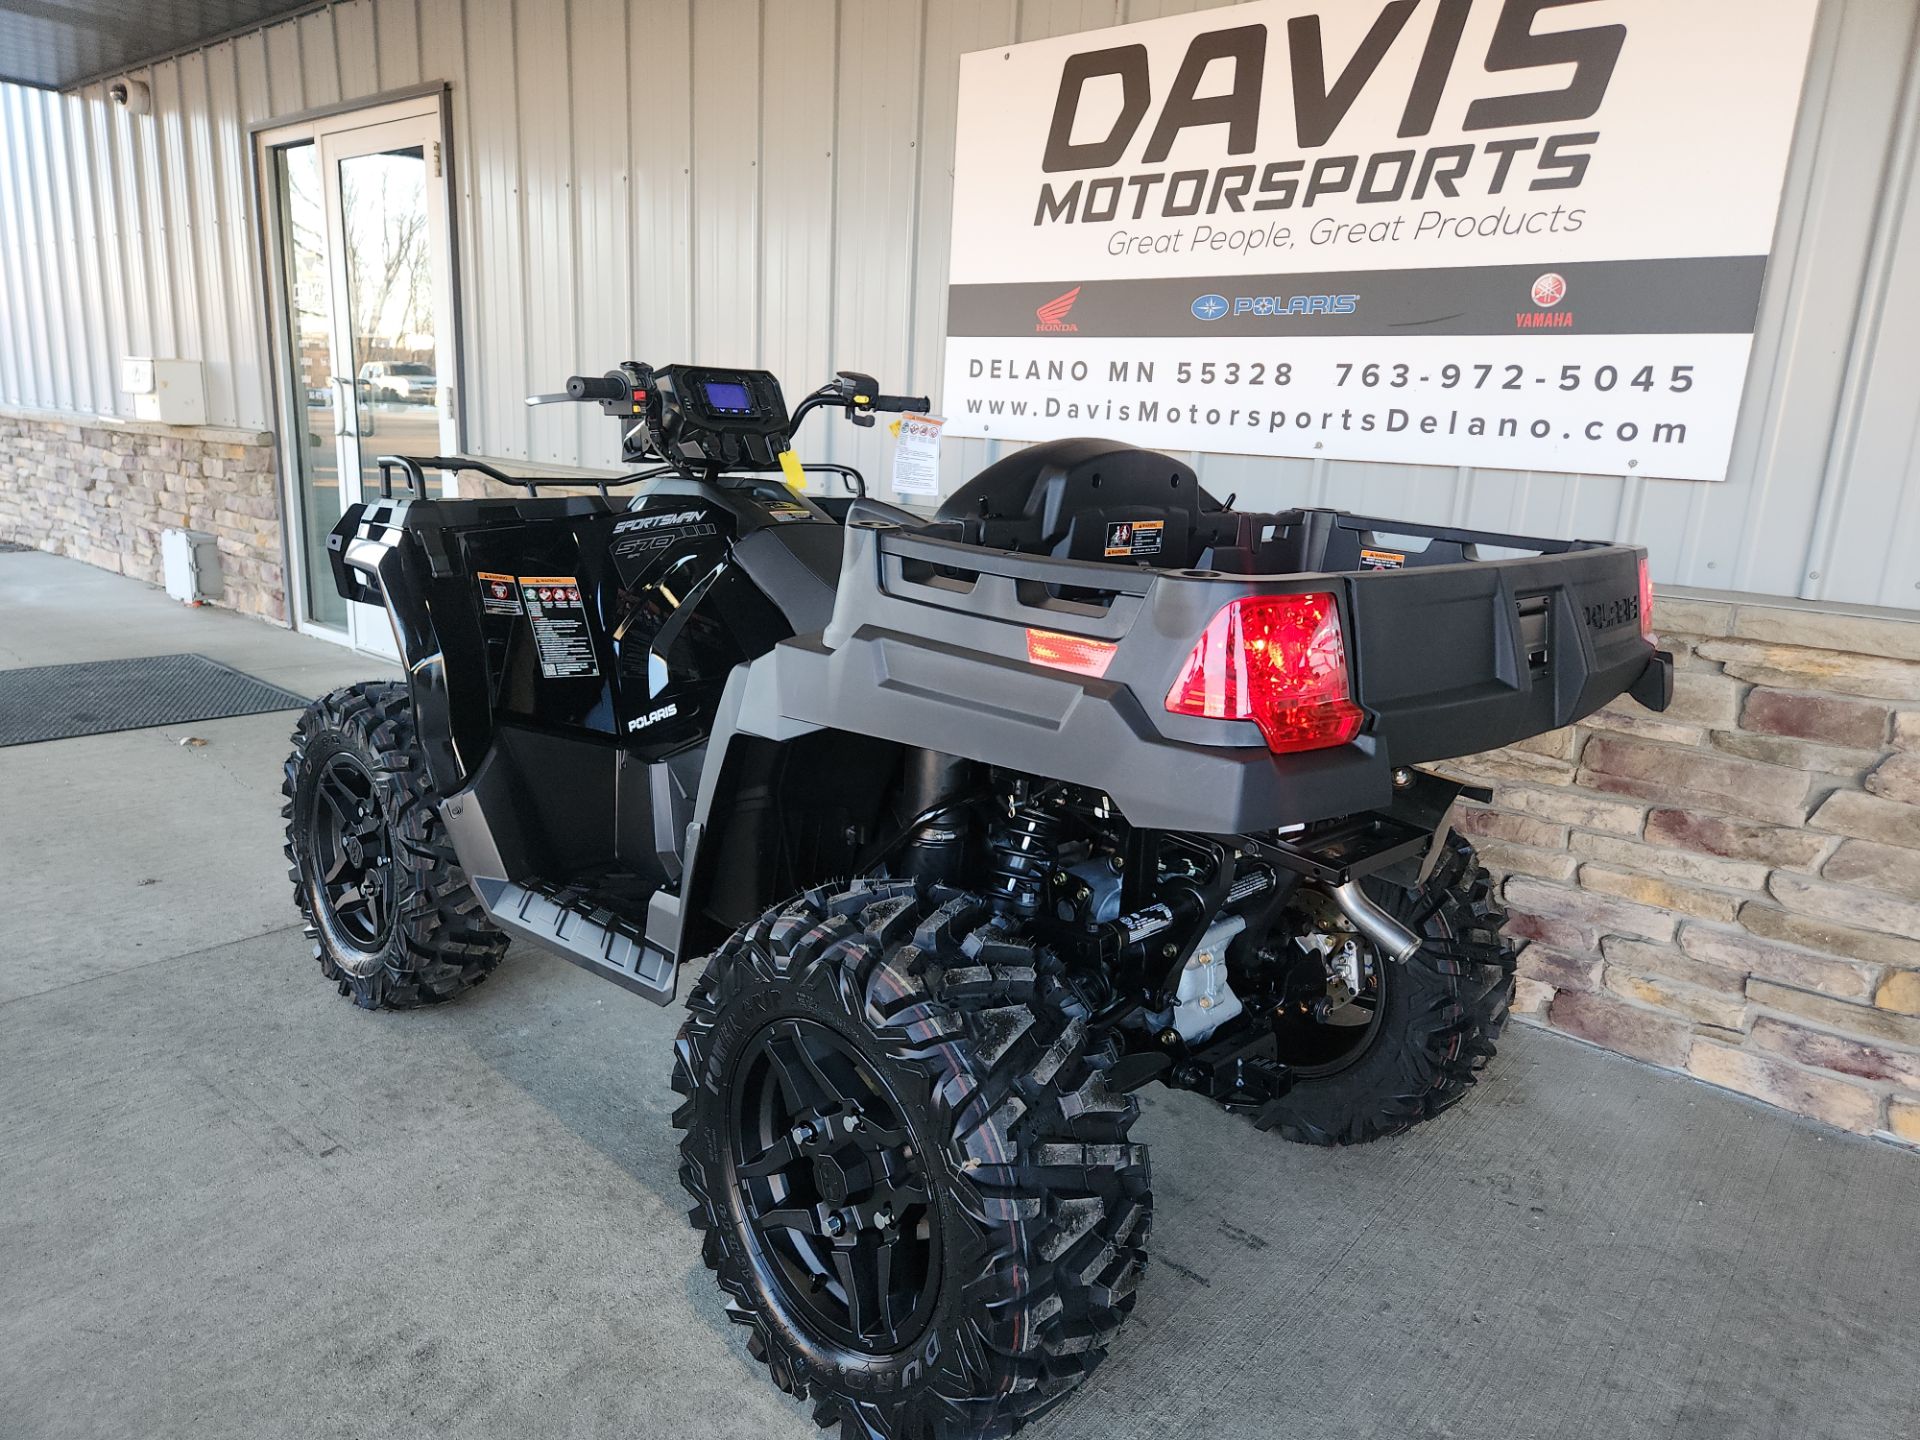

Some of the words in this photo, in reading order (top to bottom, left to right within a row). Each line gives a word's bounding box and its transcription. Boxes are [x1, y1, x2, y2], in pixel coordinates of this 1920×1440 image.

[1042, 0, 1627, 173] DAVIS
[1033, 131, 1600, 226] MOTORSPORTS
[1107, 231, 1183, 257] Great
[1190, 221, 1296, 257] People,
[1309, 214, 1405, 246] Great
[1414, 204, 1587, 242] Products
[1233, 294, 1357, 316] POLARIS
[1036, 324, 1078, 332] HONDA
[1516, 312, 1573, 328] YAMAHA
[969, 359, 1089, 382] DELANO
[1109, 361, 1155, 382] MN
[1177, 362, 1293, 386] 55328
[1335, 363, 1695, 393] 763-972-5045
[966, 397, 1688, 444] www.DavisMotorsportsDelano.com
[612, 510, 707, 534] SPORTSMAN
[615, 534, 675, 555] 570
[628, 703, 677, 732] POLARIS
